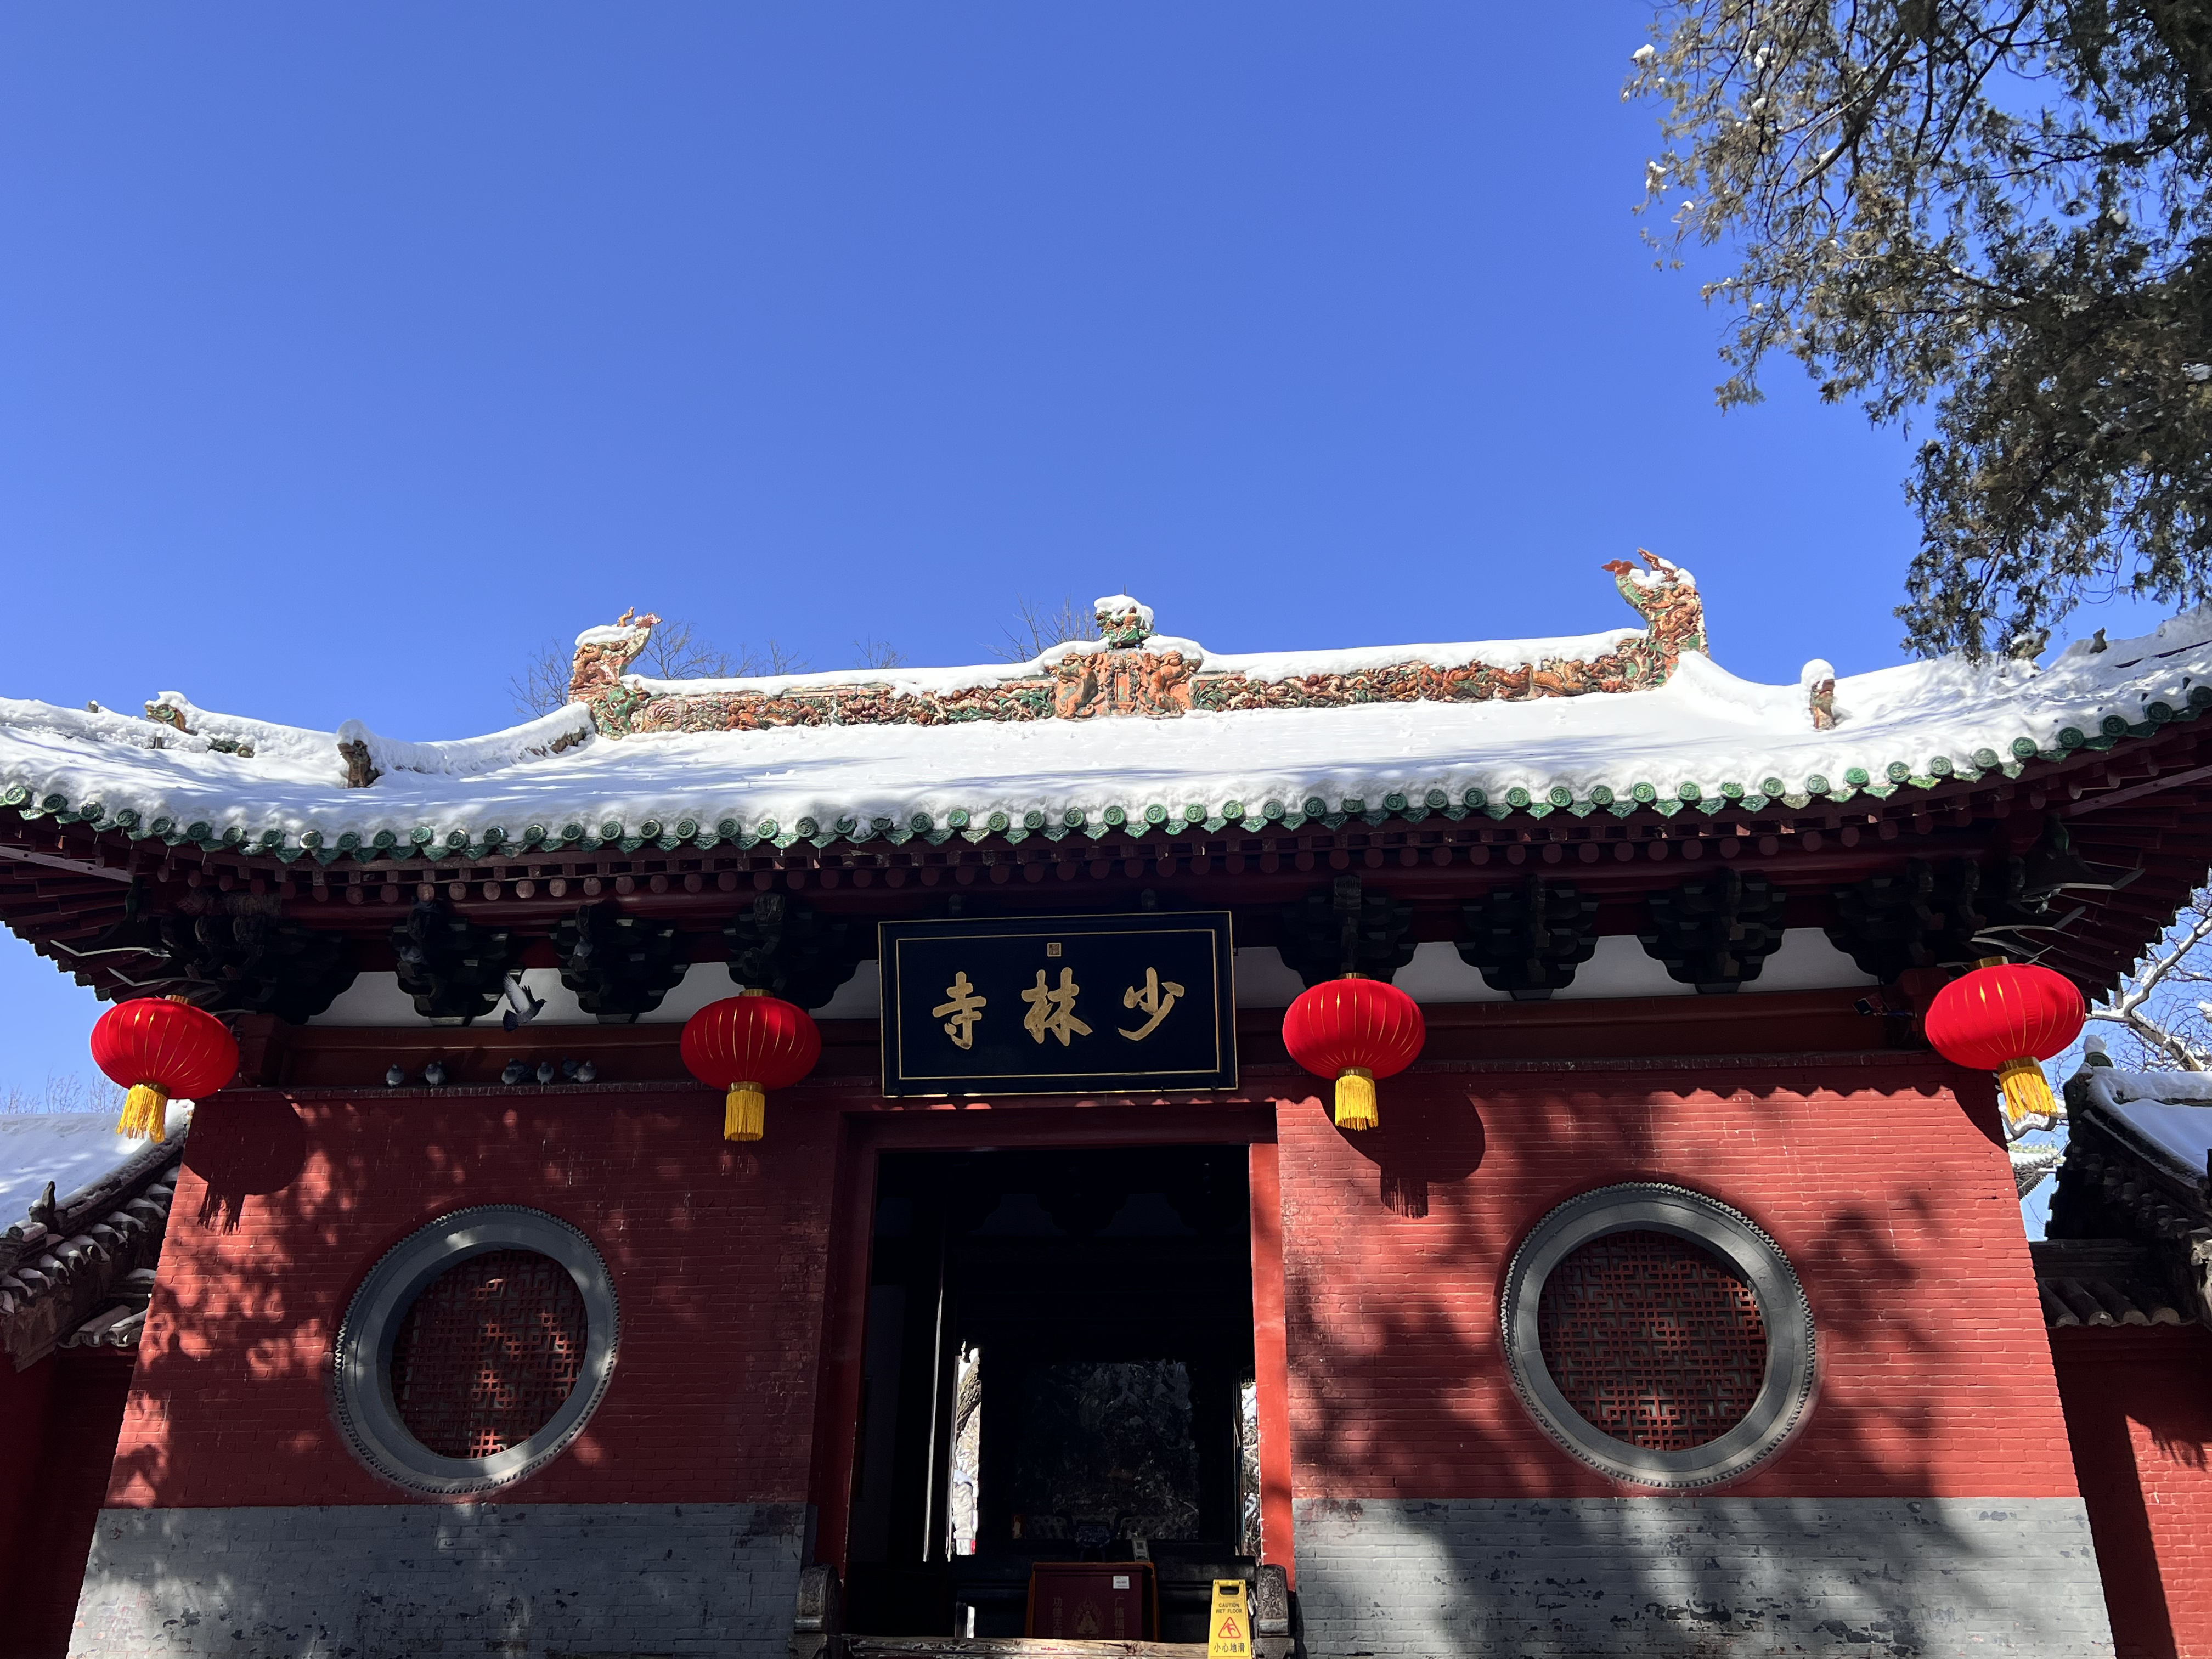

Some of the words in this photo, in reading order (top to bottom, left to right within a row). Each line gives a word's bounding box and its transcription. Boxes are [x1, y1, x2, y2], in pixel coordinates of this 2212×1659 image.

[932, 967, 1184, 1049] 少林寺
[1214, 1643, 1244, 1652] 小心地滑
